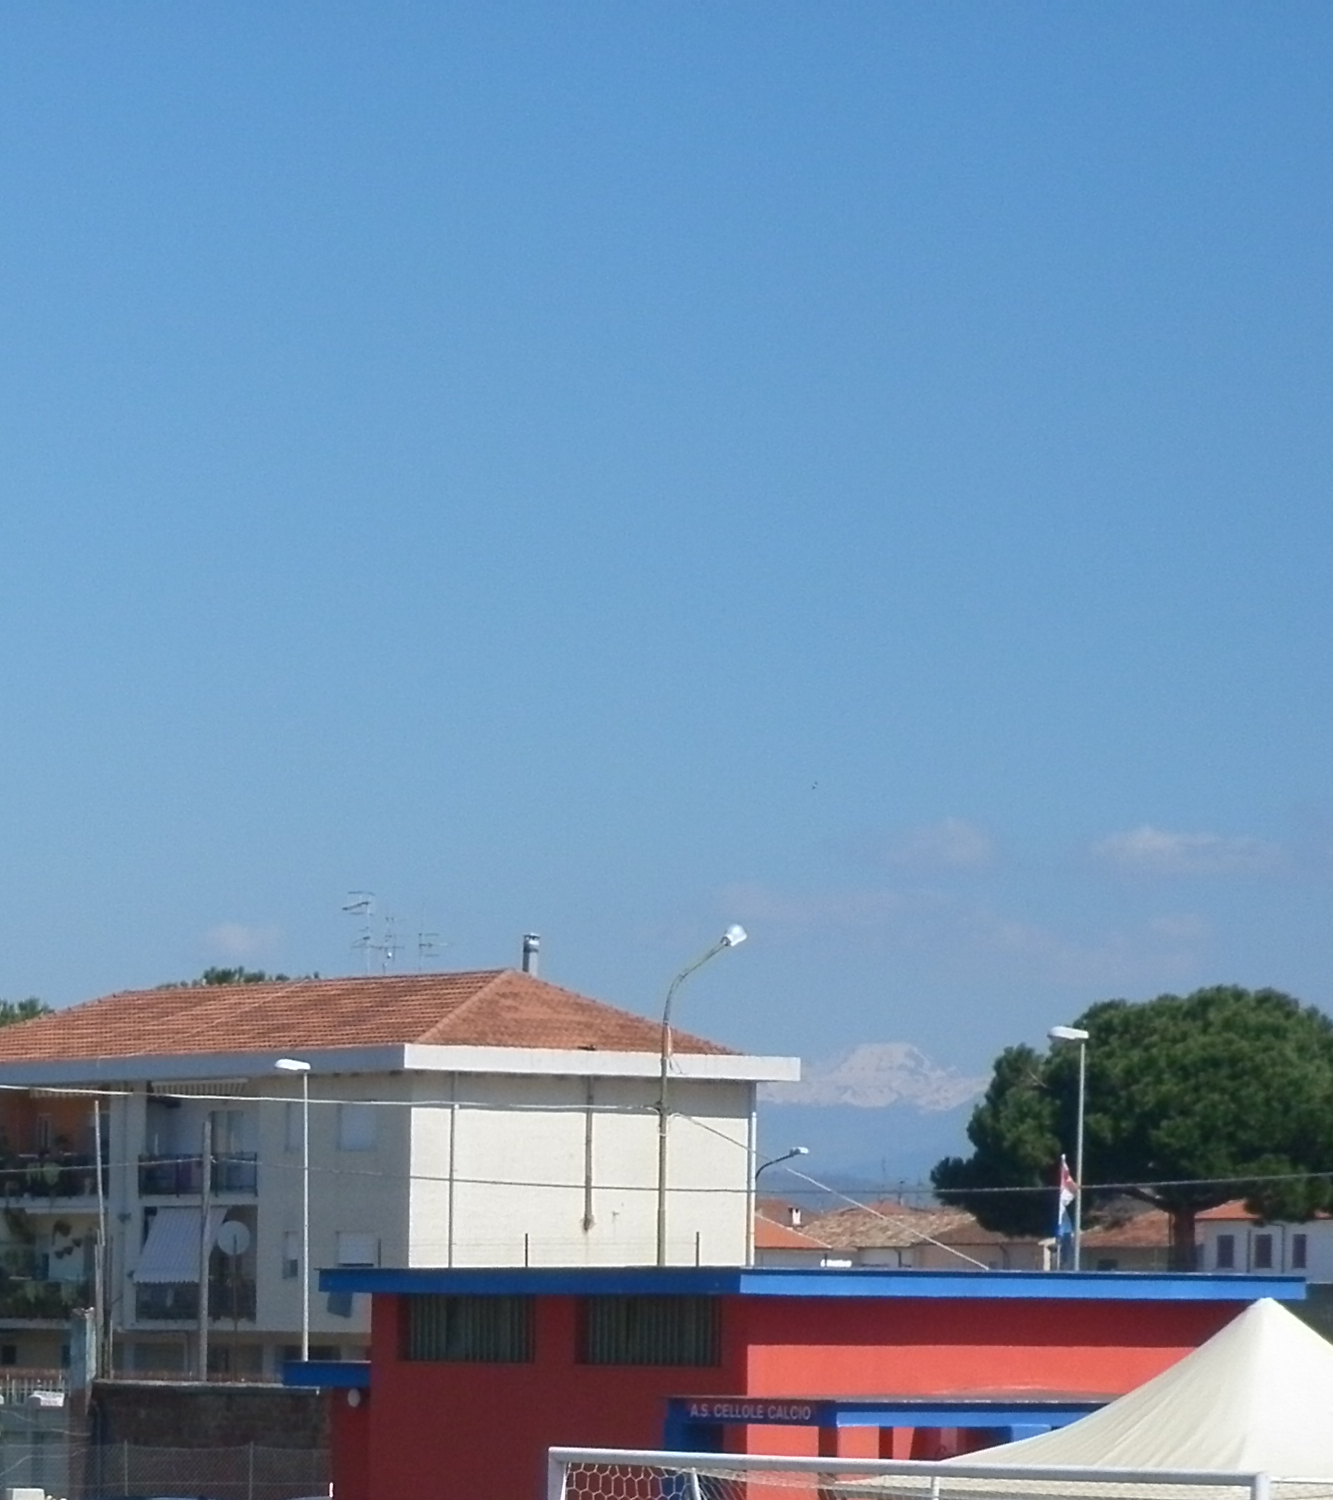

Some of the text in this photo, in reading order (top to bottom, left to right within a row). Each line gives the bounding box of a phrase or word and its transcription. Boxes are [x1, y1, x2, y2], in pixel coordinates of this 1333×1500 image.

[690, 1403, 812, 1420] A.S. CELLOLE CALCIO
